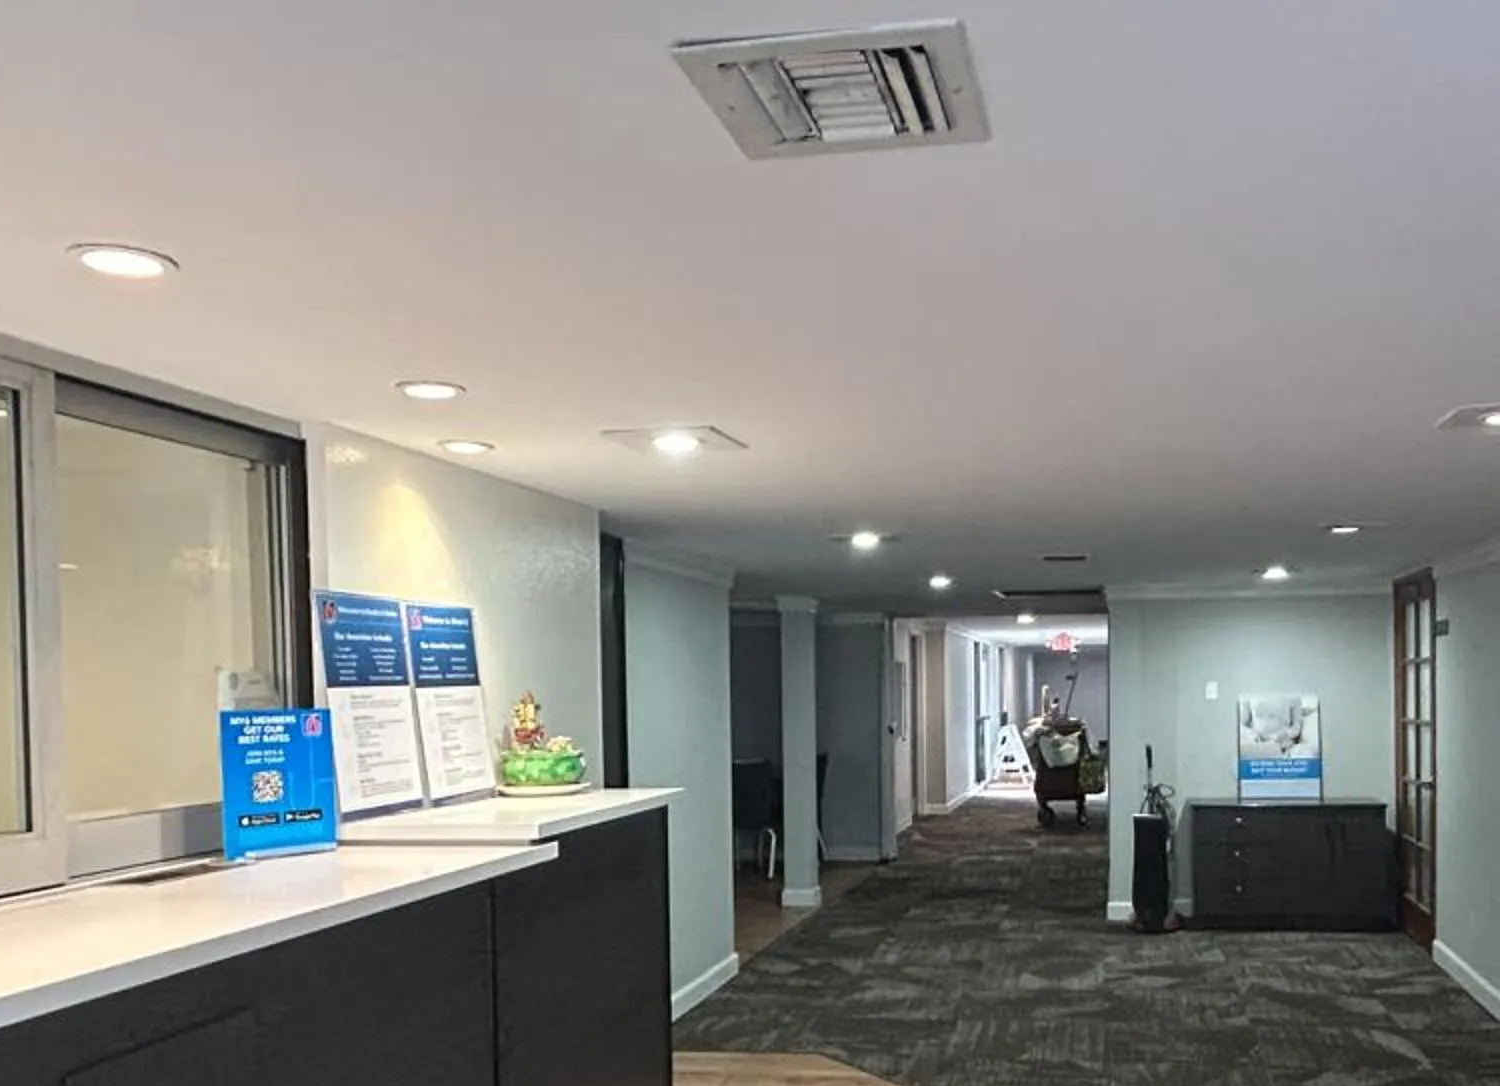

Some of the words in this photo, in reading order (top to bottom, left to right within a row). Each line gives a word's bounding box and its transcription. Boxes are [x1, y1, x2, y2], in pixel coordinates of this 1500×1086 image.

[252, 714, 297, 725] MEMBERS
[243, 725, 261, 735] GET
[263, 724, 285, 734] OUR
[237, 735, 260, 745] BEST
[262, 733, 291, 743] RATES
